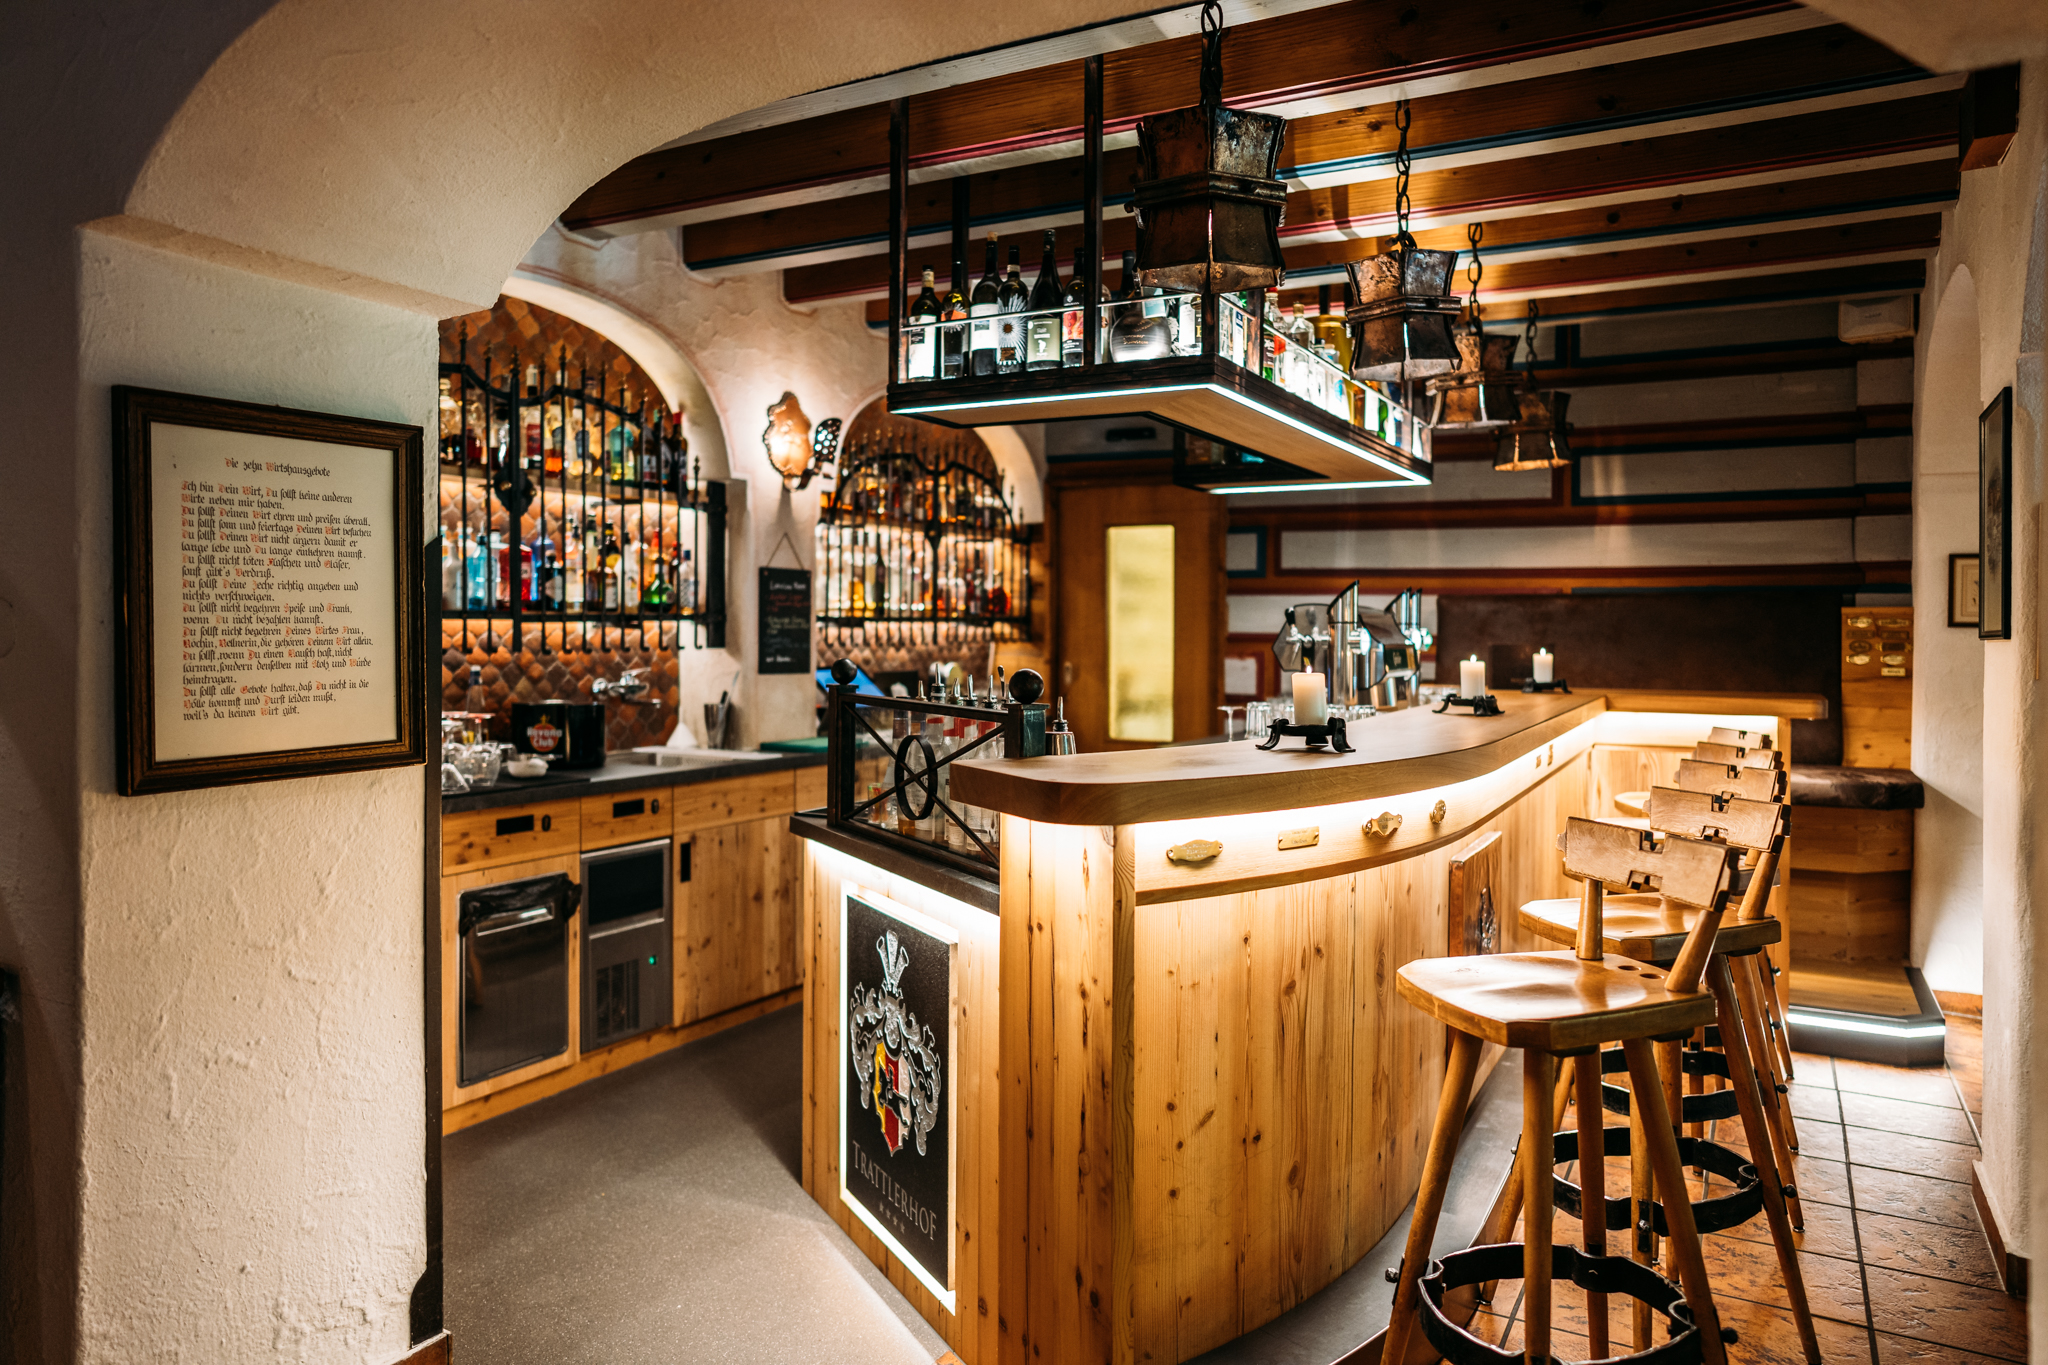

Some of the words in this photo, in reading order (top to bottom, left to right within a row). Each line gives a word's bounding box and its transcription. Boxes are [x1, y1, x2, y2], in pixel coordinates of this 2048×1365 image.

[225, 458, 238, 468] Die
[266, 462, 330, 477] Wirtshausgebote
[533, 739, 554, 747] Club
[852, 1140, 937, 1240] TRATTLERHOF
